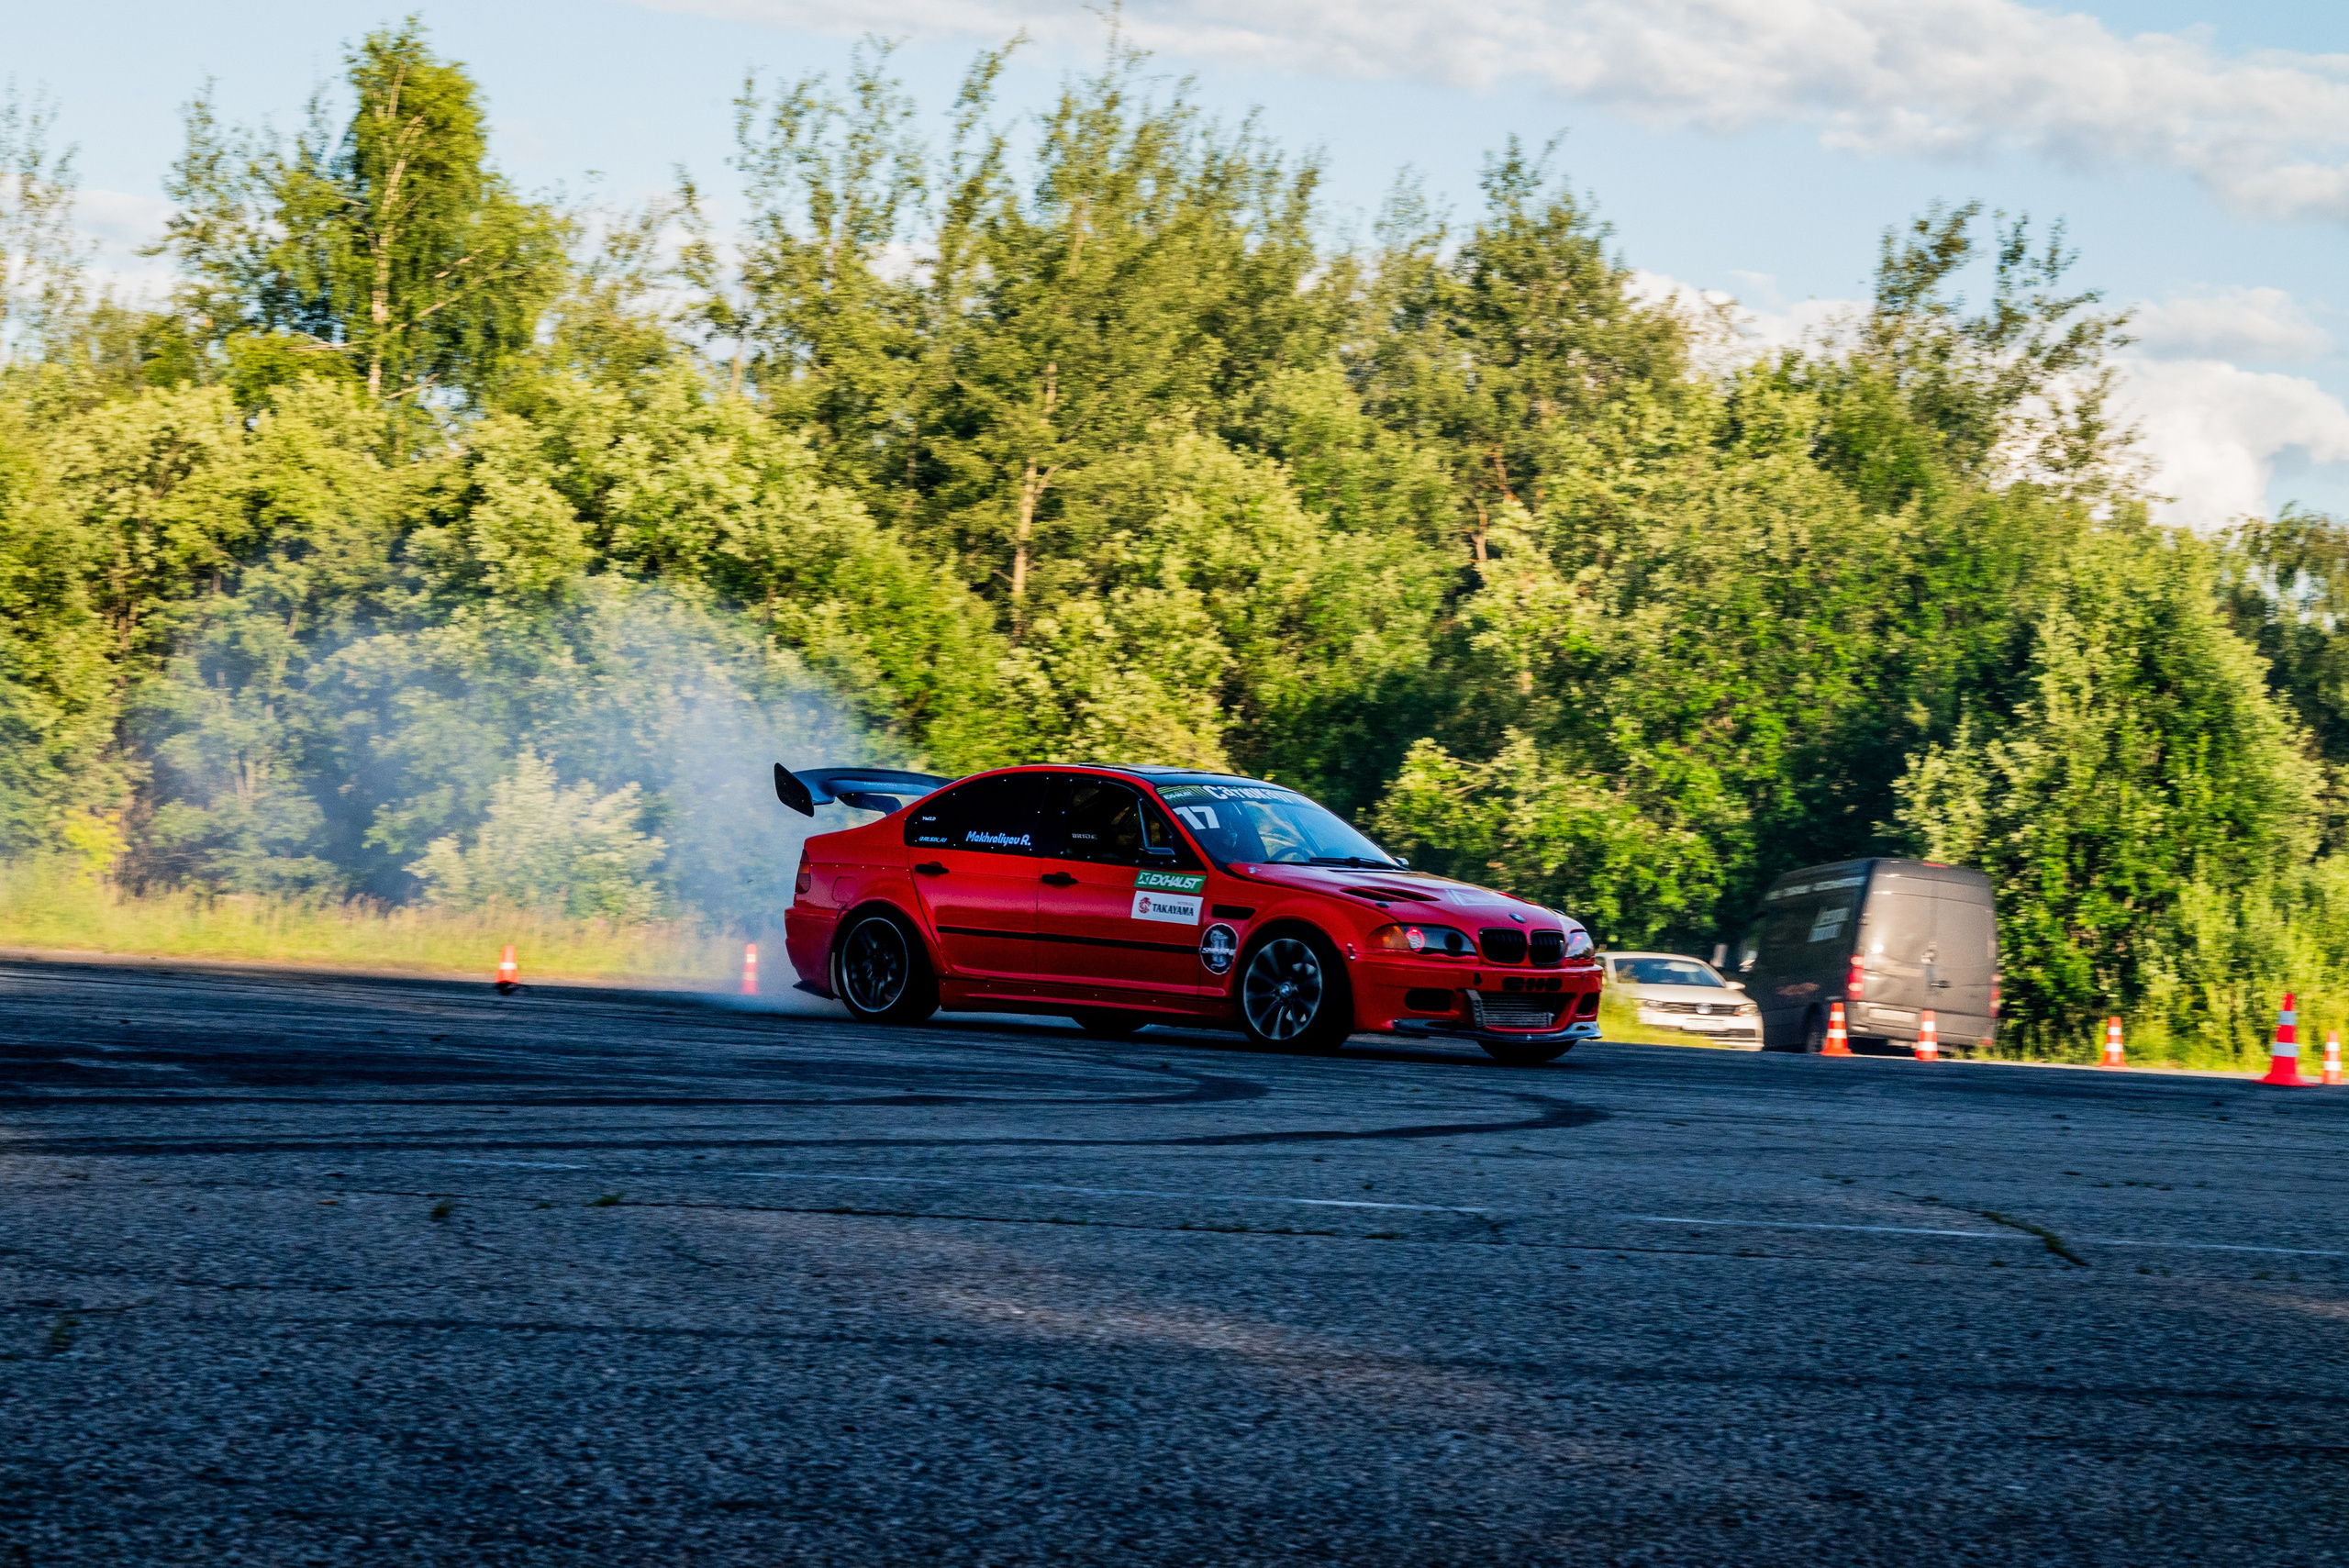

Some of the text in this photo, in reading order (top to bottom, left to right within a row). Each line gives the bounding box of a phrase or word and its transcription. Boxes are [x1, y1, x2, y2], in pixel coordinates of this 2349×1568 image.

[1172, 806, 1220, 830] 17
[1019, 833, 1031, 846] R.
[1149, 873, 1202, 889] EXHAUST
[1152, 904, 1194, 916] TAKAYAMA
